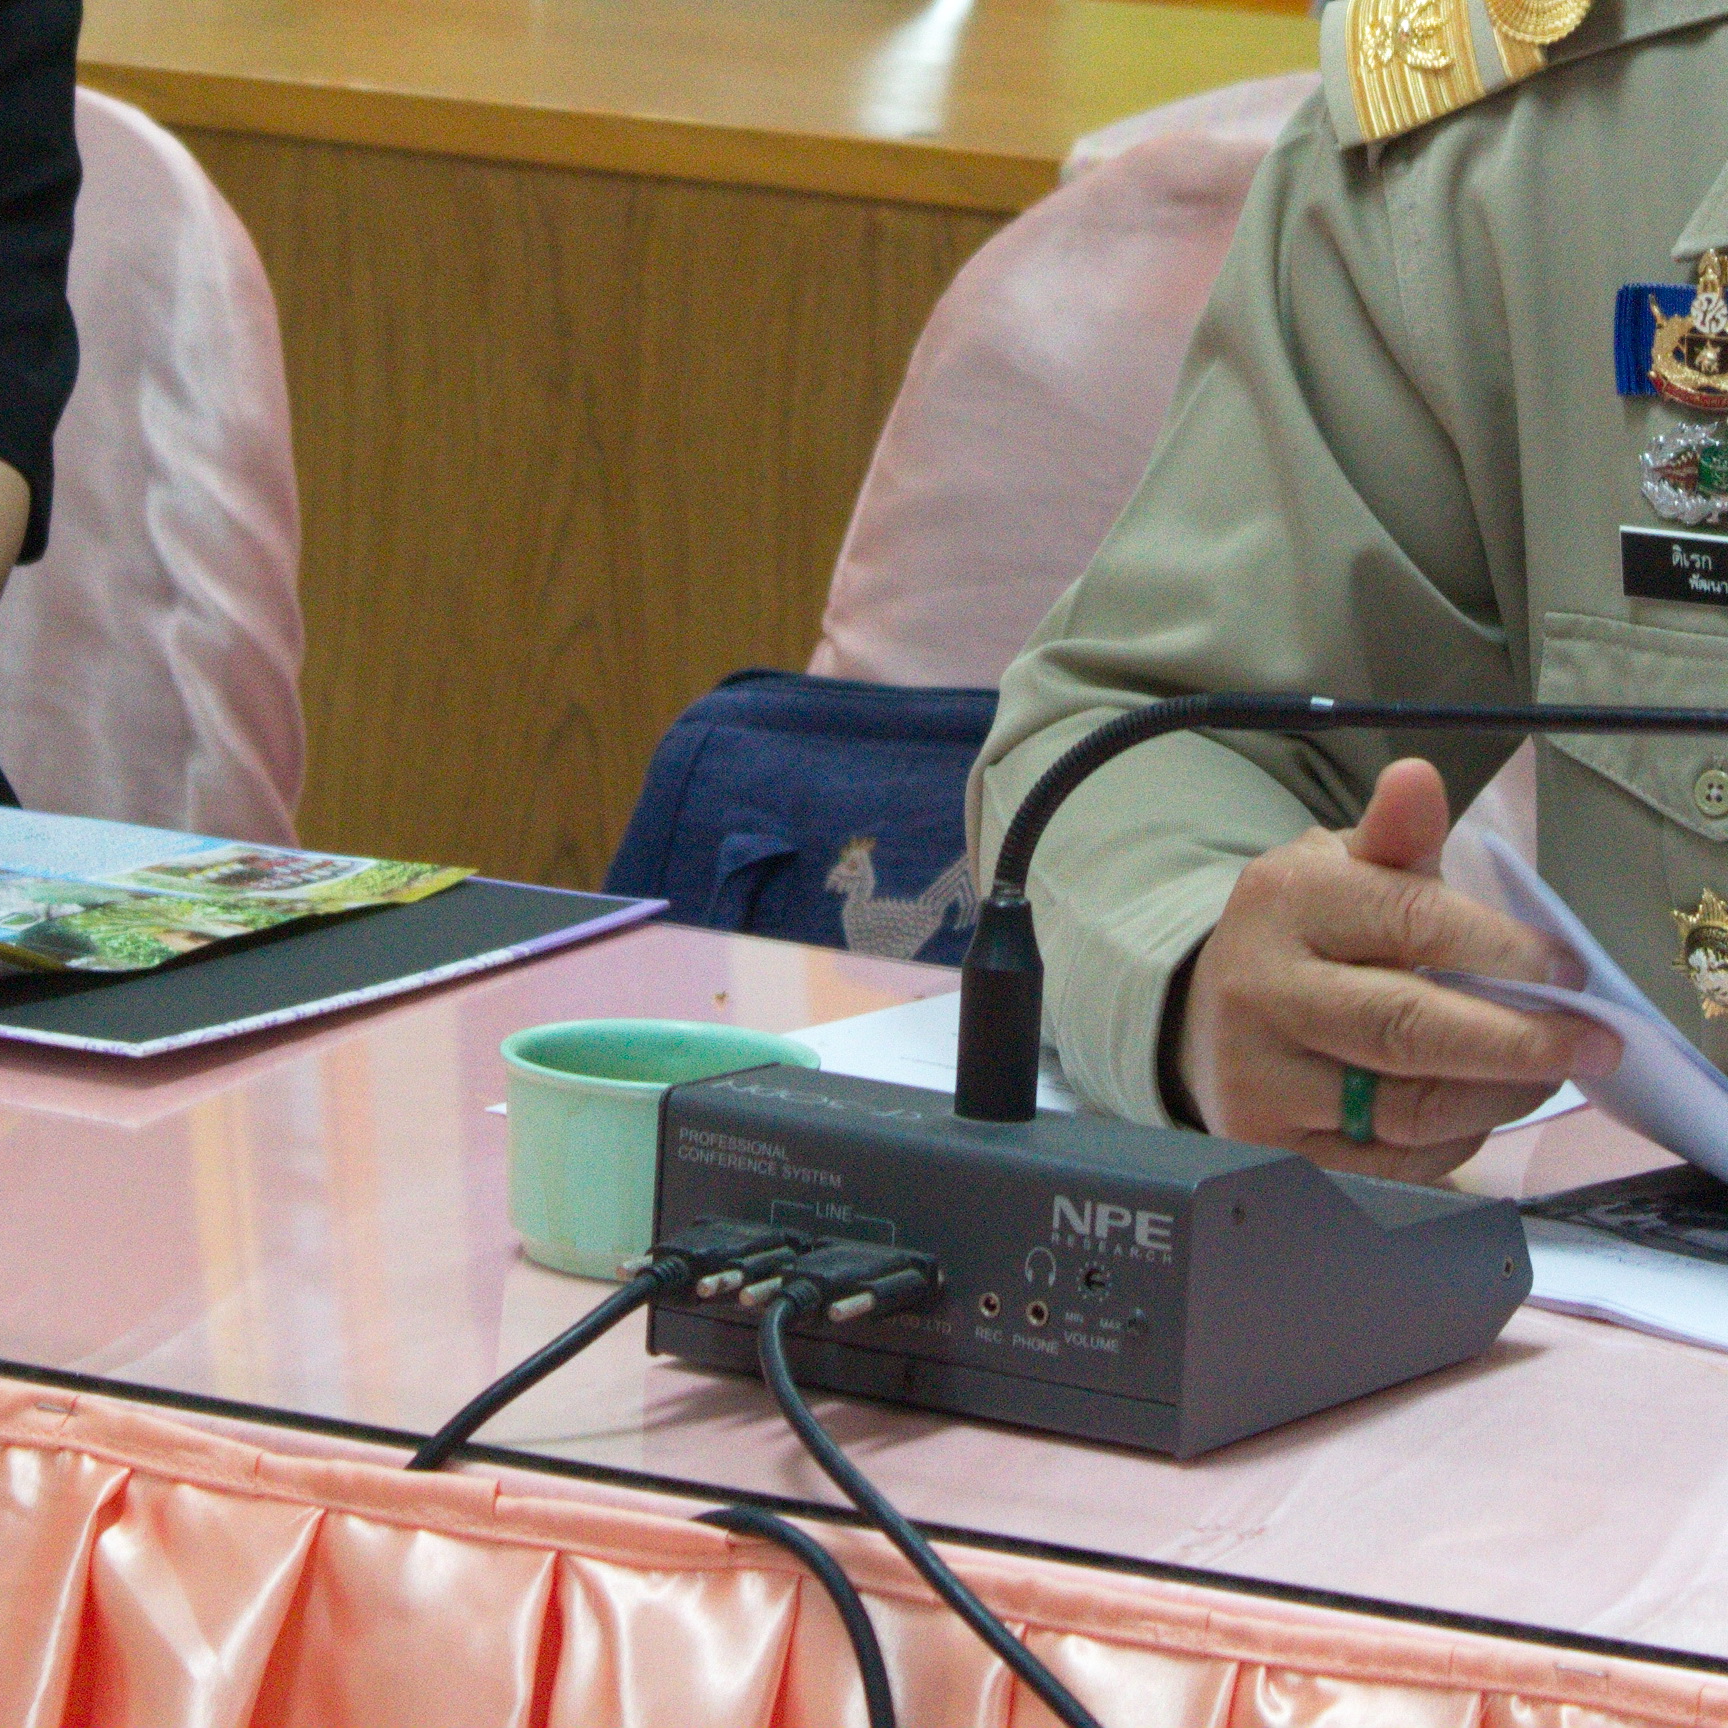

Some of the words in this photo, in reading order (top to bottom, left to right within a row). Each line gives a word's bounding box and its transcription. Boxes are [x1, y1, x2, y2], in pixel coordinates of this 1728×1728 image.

[1671, 543, 1713, 572] ดิเรก
[678, 1127, 790, 1161] PROFESSIONAL
[677, 1147, 777, 1177] CONFERENCE
[782, 1163, 843, 1188] SYSTEM
[815, 1202, 855, 1223] LINE
[1051, 1193, 1176, 1254] NPE
[1050, 1232, 1174, 1265] RESEARCH
[1064, 1310, 1085, 1325] MIN
[1099, 1316, 1123, 1331] MAX
[974, 1325, 1005, 1345] REC
[1011, 1333, 1062, 1358] PHONE
[1062, 1329, 1122, 1355] VOLUME
